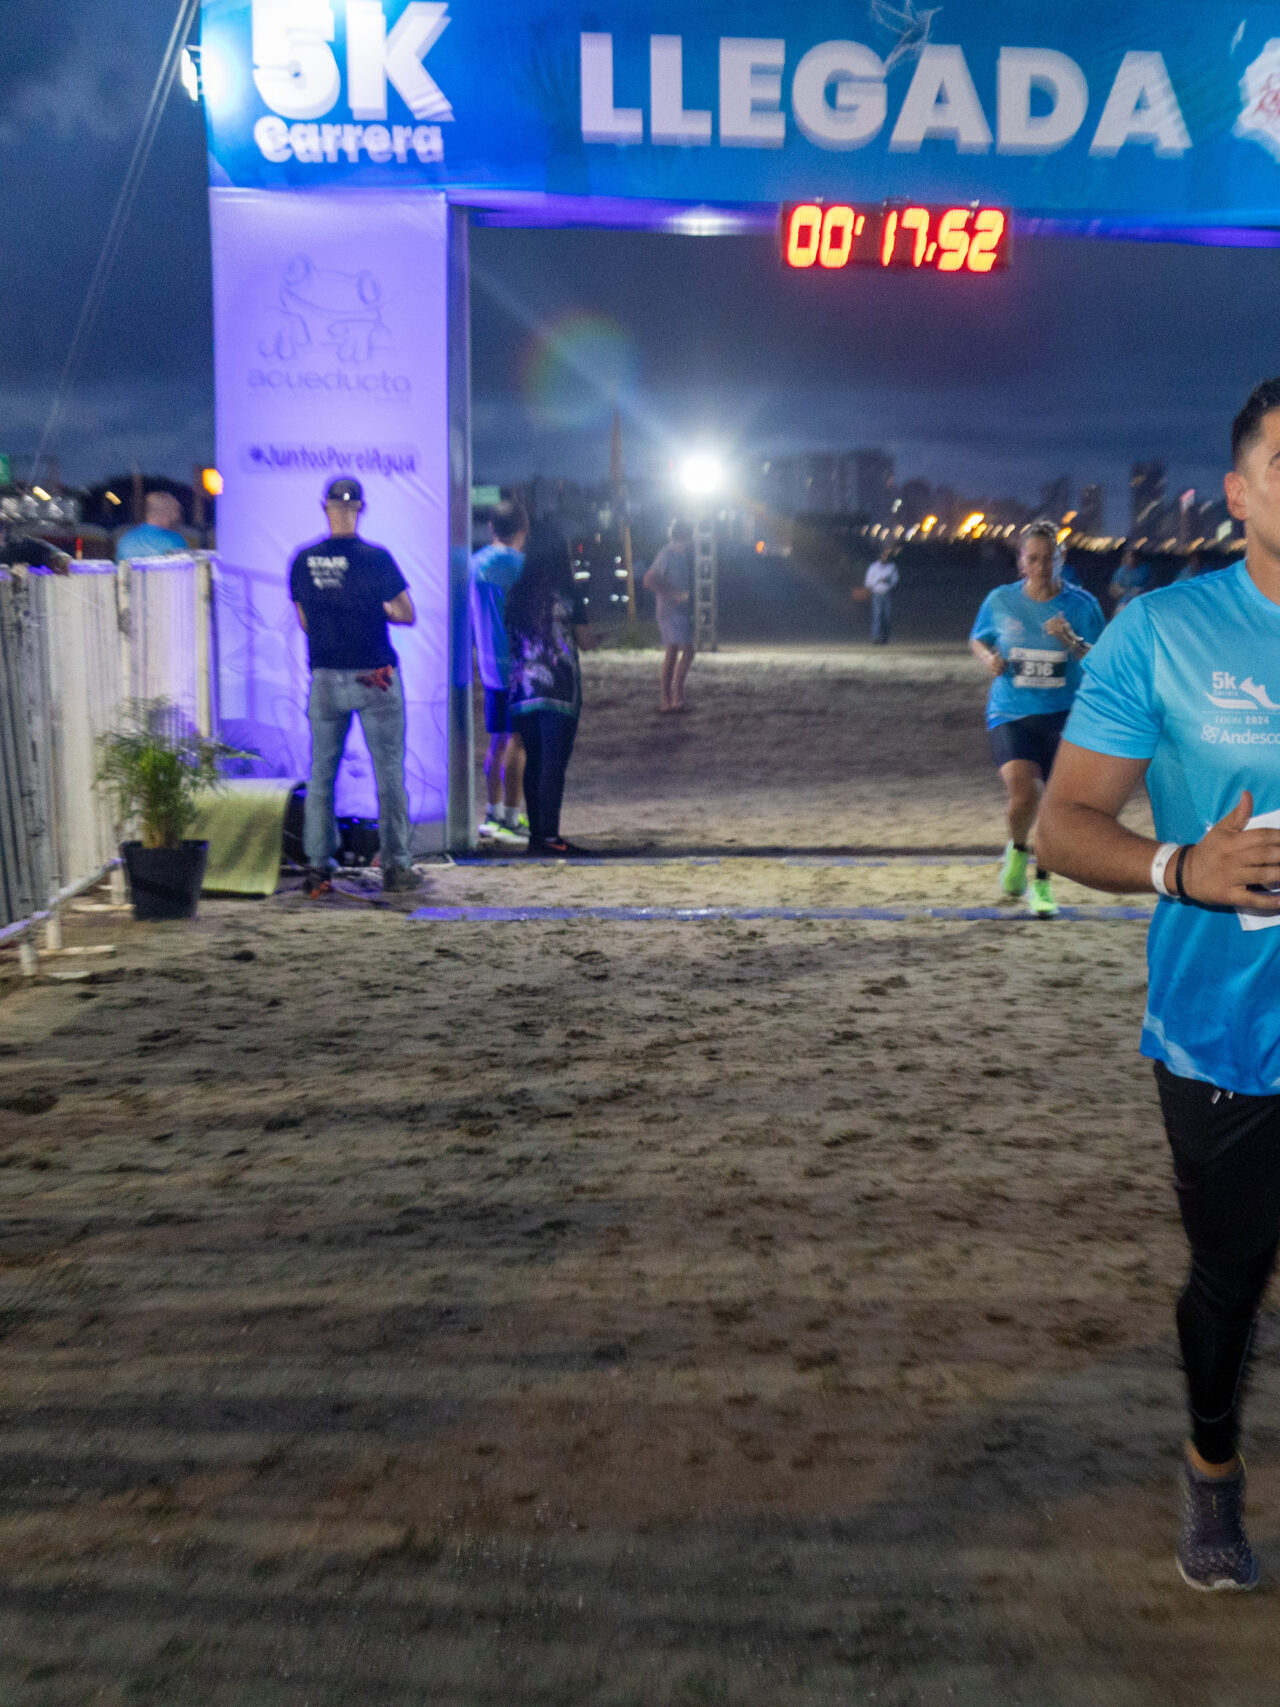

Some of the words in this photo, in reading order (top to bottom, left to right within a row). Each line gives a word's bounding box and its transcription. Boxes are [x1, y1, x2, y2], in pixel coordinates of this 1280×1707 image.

[251, 0, 455, 121] 5K
[580, 32, 1193, 157] LLEGADA
[253, 115, 444, 163] Carrera
